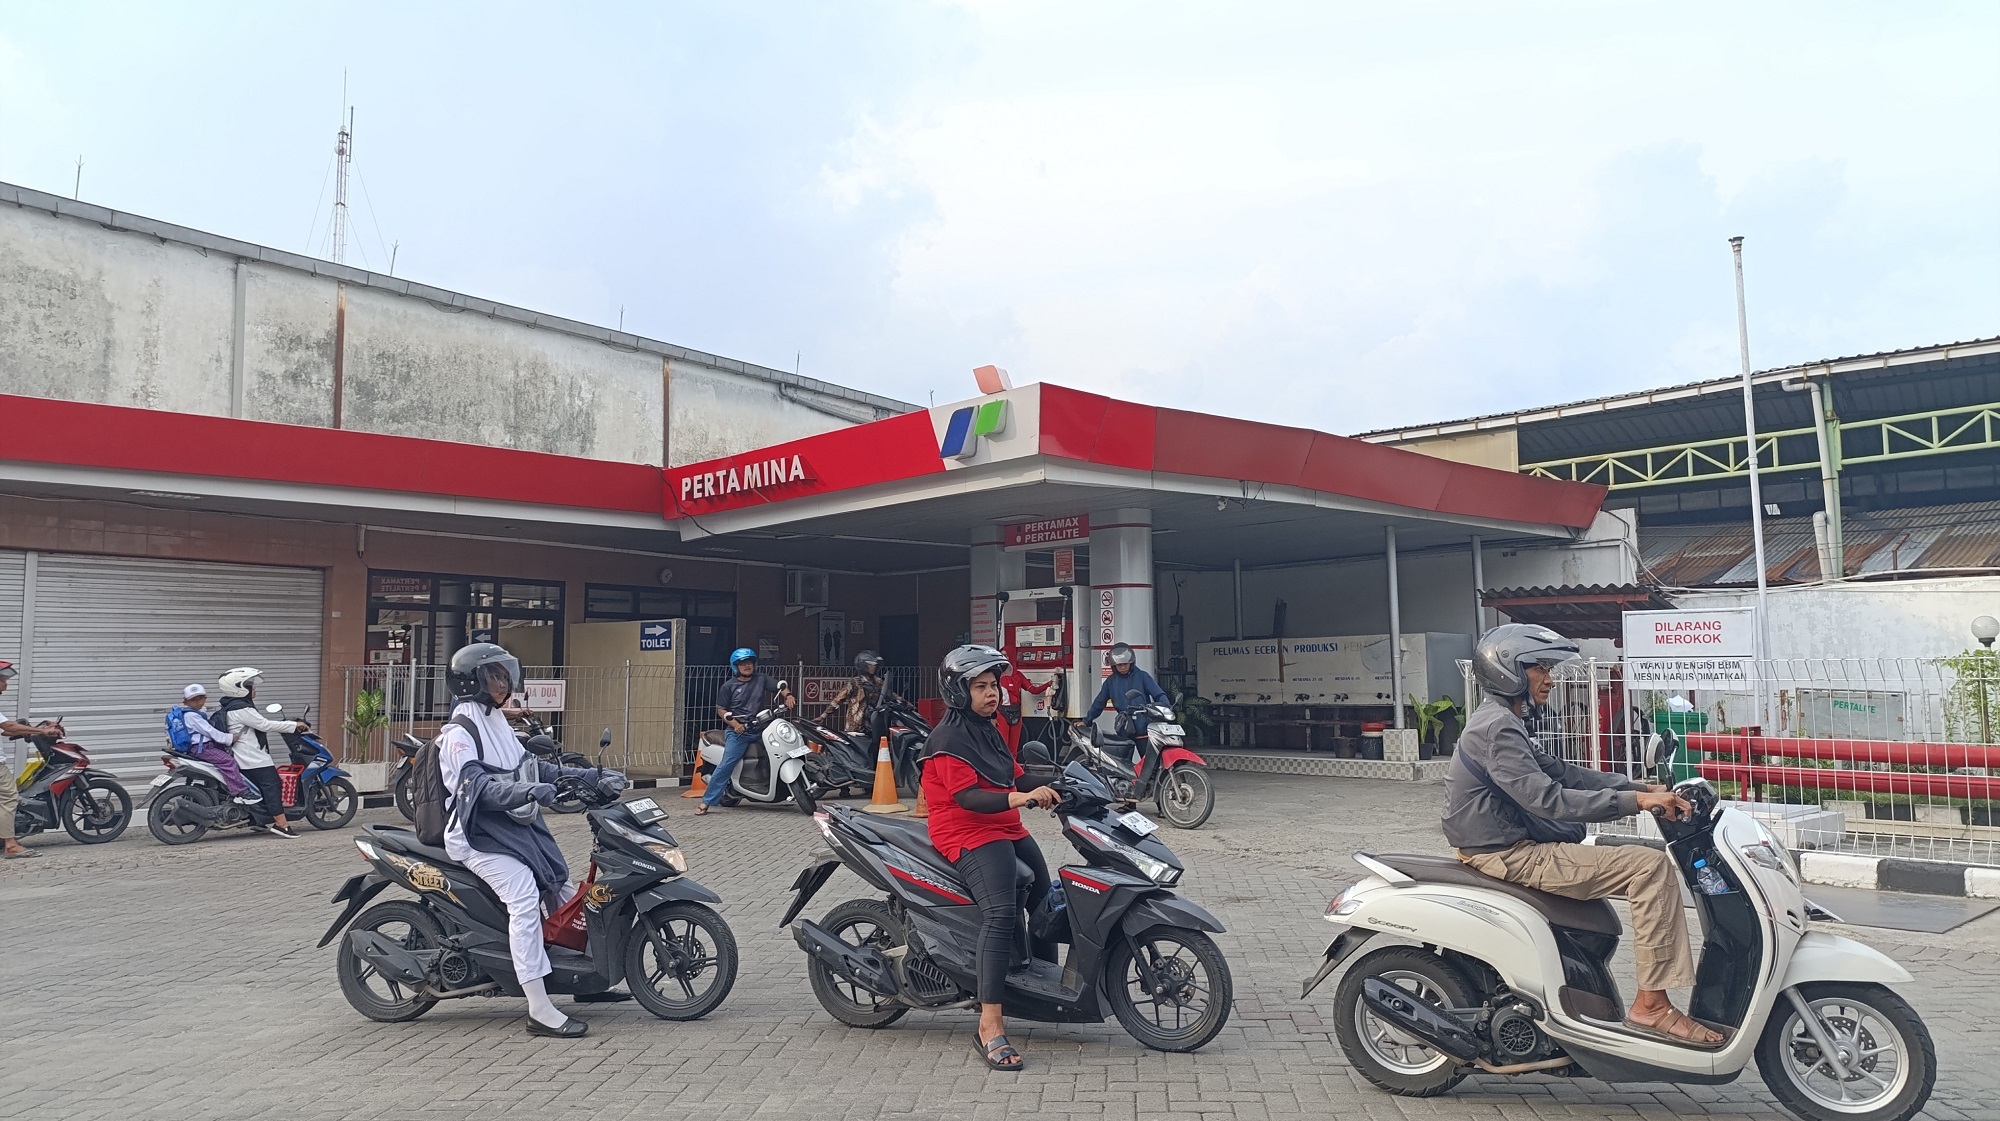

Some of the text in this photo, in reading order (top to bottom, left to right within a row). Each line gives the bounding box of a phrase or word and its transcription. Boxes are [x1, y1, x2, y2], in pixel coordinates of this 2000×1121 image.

[681, 454, 805, 501] PERTAMINA
[1024, 517, 1079, 532] PERTAMAX
[1024, 528, 1080, 543] PERTALITE
[1655, 620, 1722, 632] DILARANG
[641, 638, 671, 648] TOILET
[1655, 633, 1722, 645] MEROKOK
[1213, 646, 1250, 656] PELUMAS
[1254, 645, 1289, 655] ECERN
[1294, 642, 1339, 653] PRODUKSI
[1718, 661, 1741, 669] BBM
[1633, 672, 1660, 681] MESIN
[822, 681, 845, 690] DILARA
[541, 687, 557, 698] DUA
[1833, 700, 1876, 713] PERTALITE
[632, 860, 657, 872] HONDA
[1071, 880, 1101, 895] HONDA
